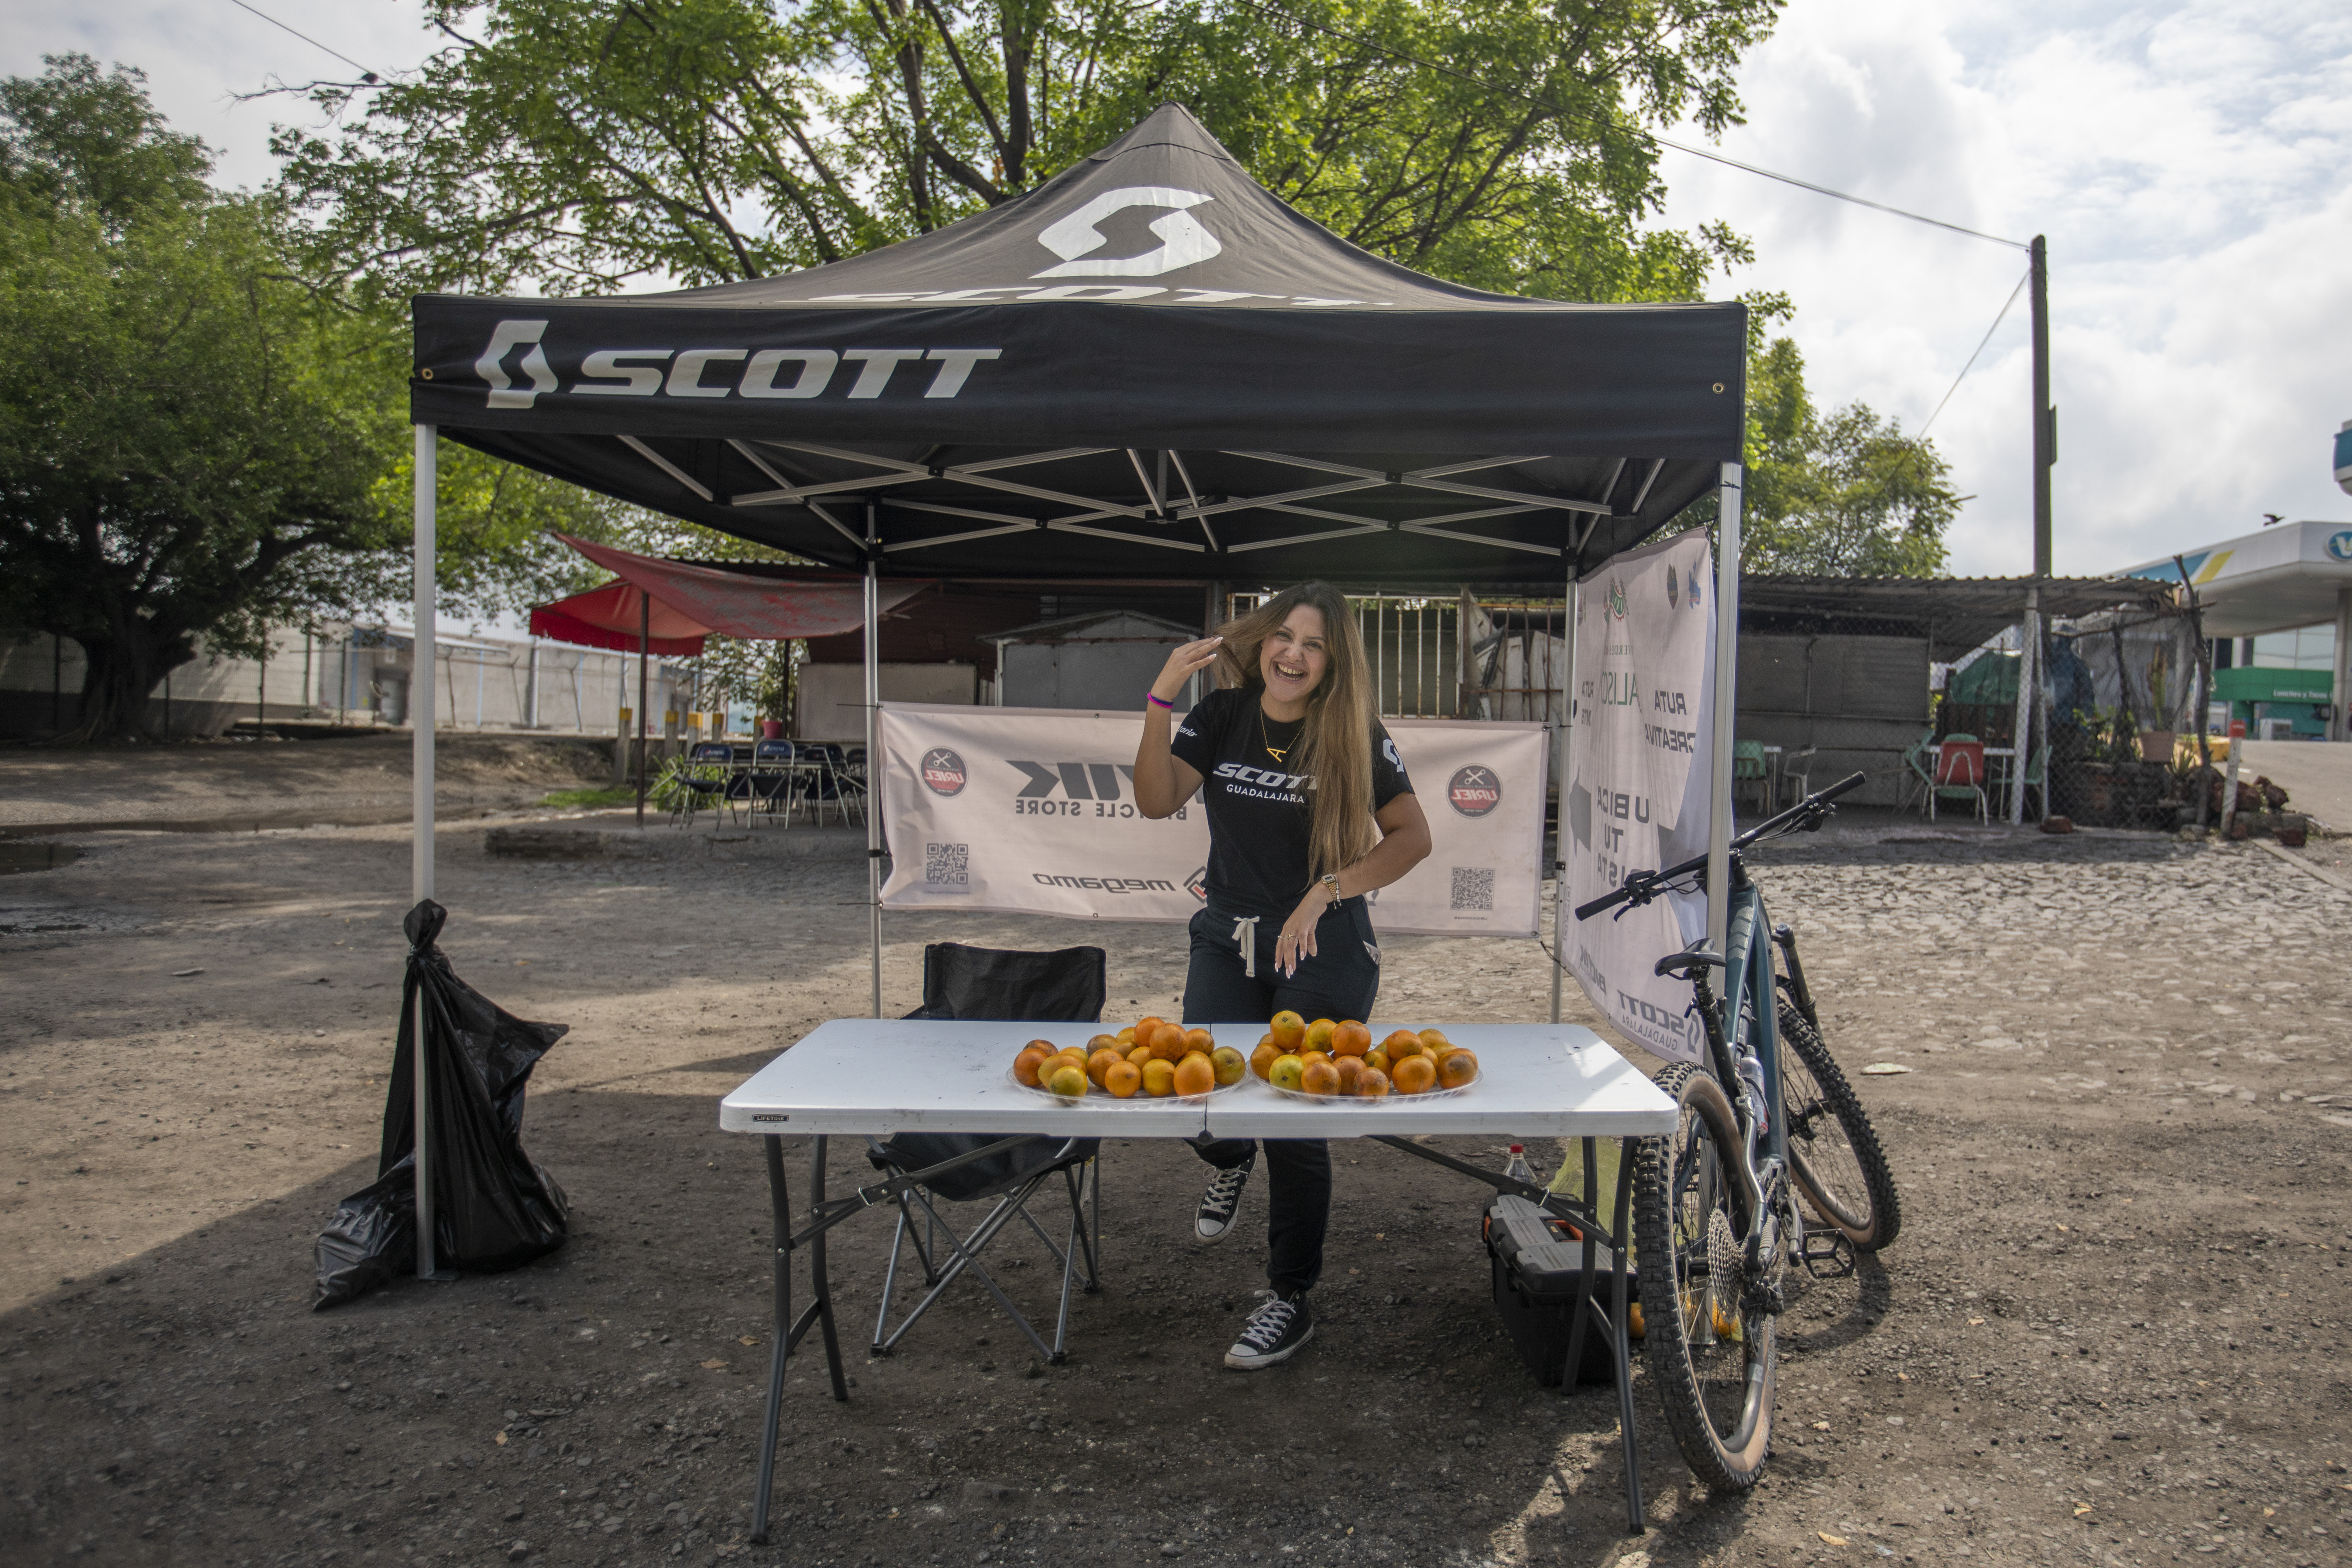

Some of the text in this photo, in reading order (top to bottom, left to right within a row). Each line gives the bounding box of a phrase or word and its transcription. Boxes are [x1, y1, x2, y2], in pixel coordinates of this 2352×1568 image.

[570, 349, 1003, 399] SCOTT
[1178, 725, 1196, 737] toria
[1227, 784, 1305, 803] GUADALAJARA
